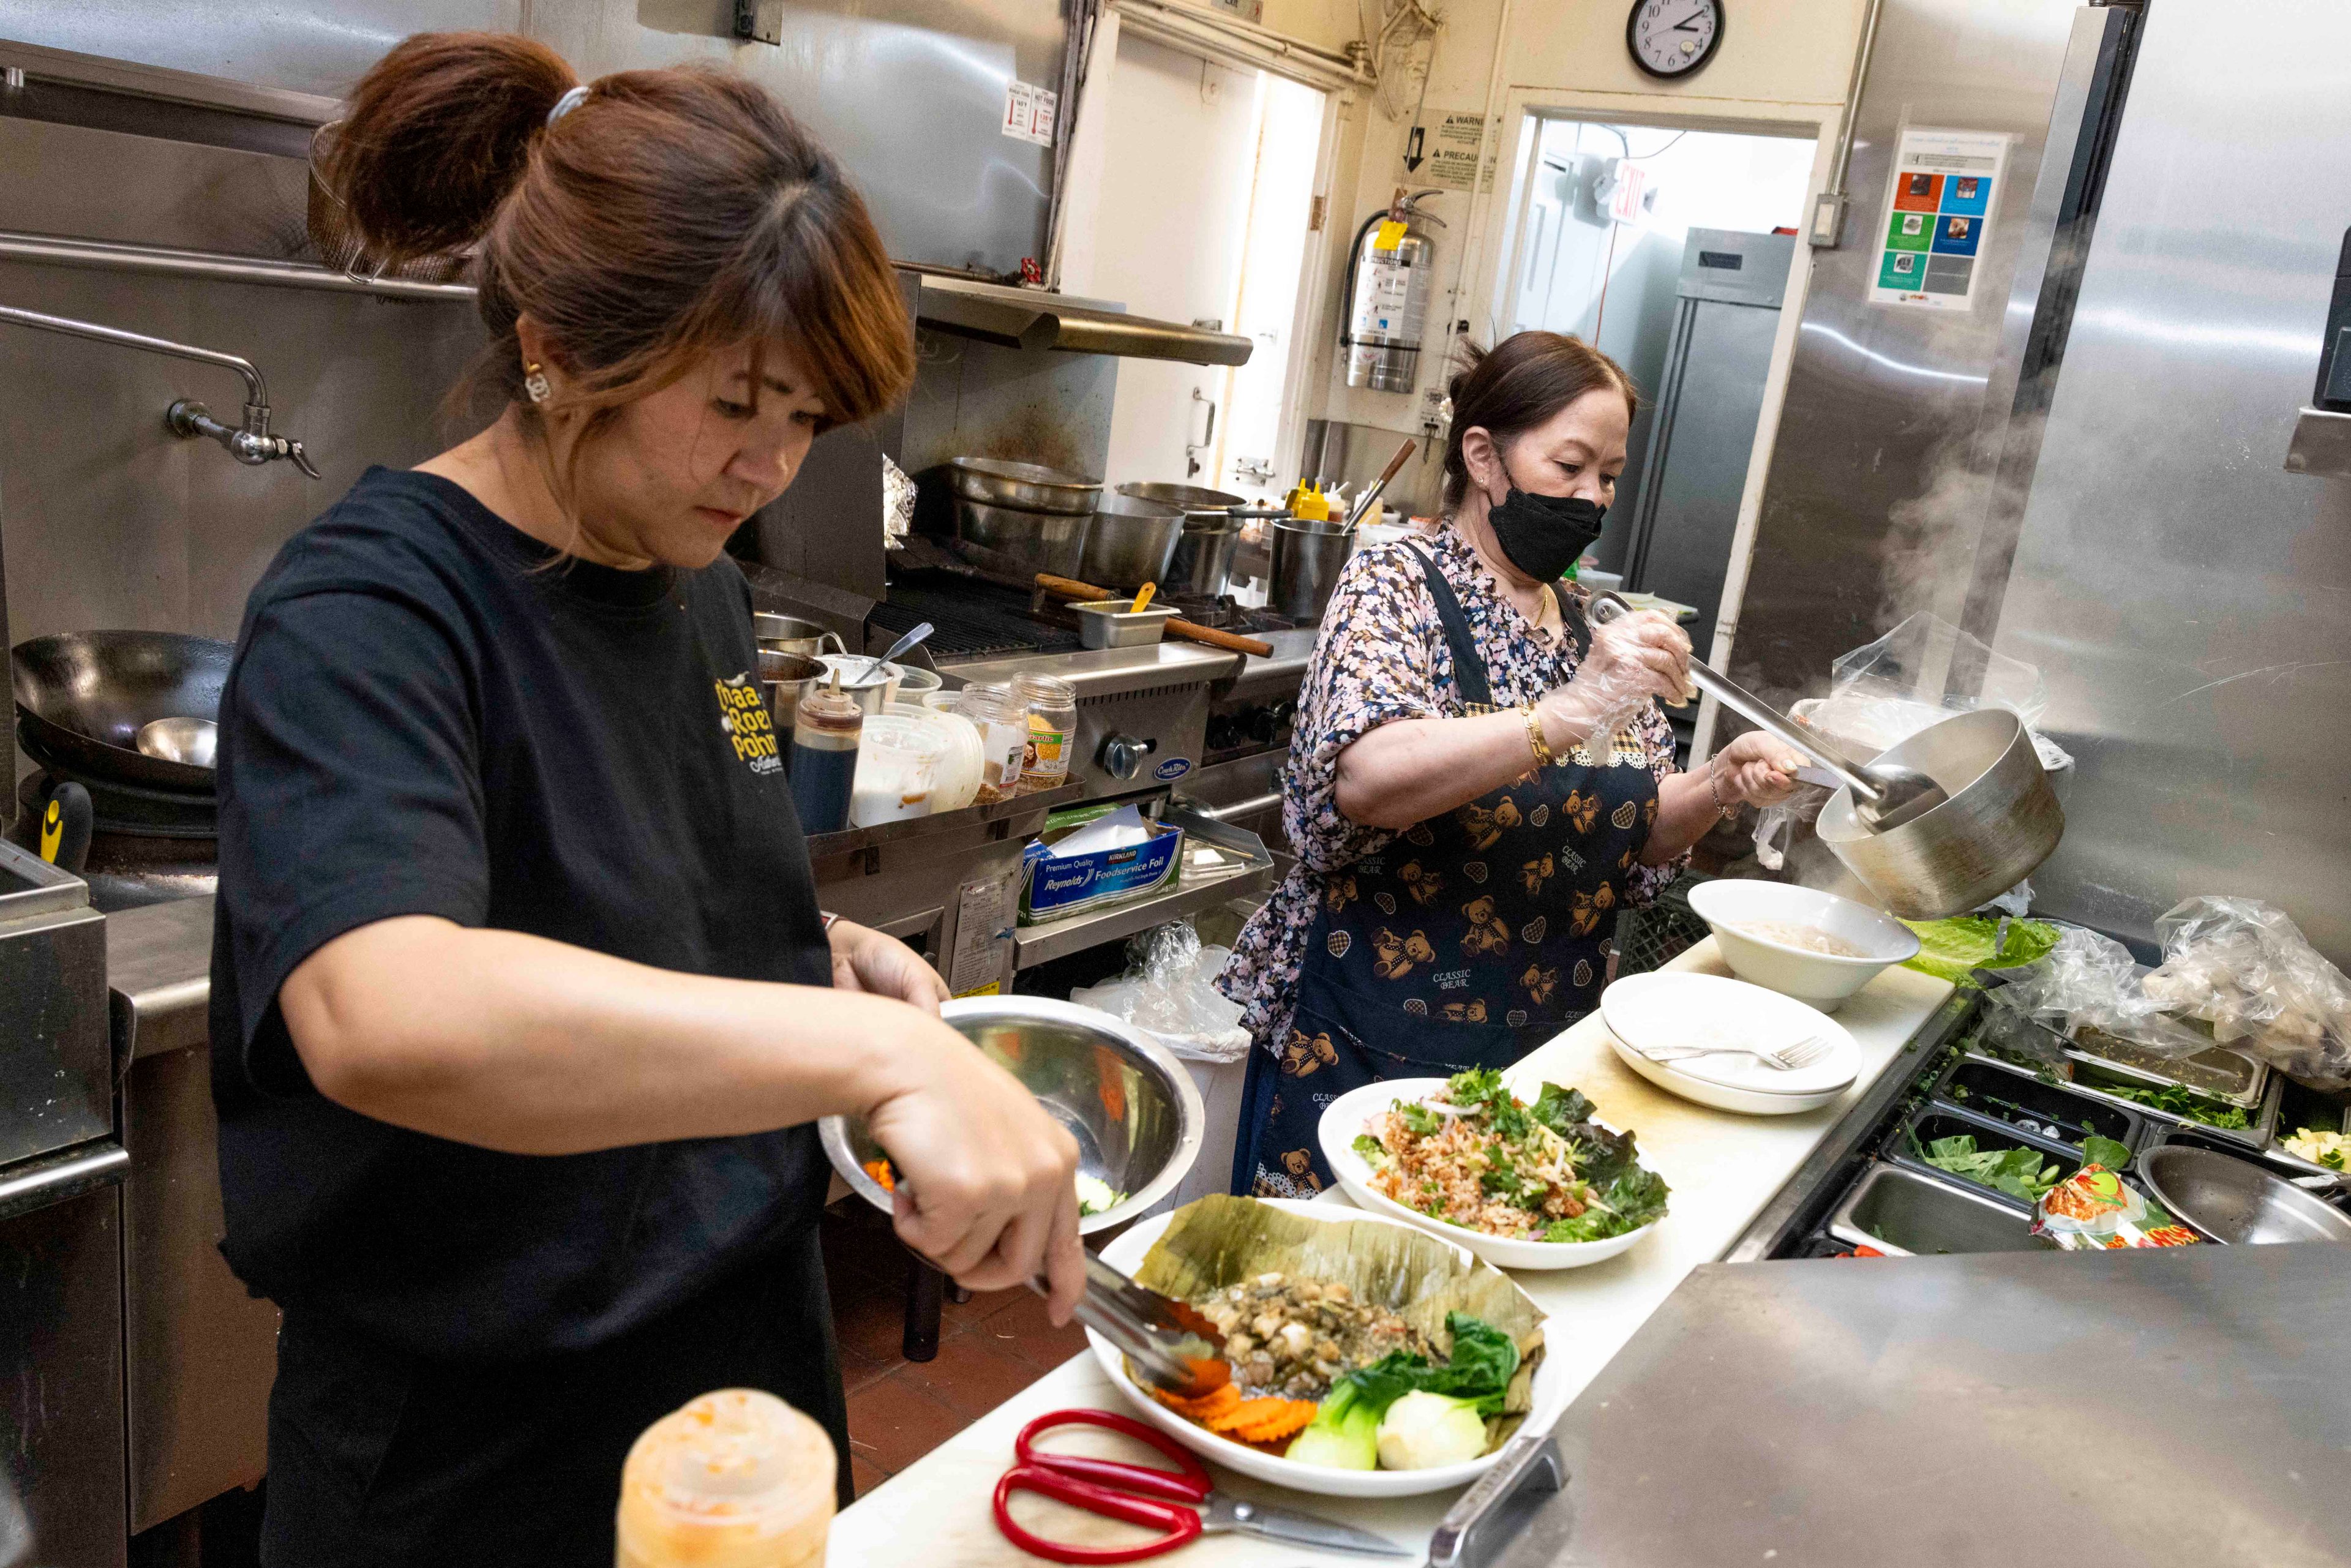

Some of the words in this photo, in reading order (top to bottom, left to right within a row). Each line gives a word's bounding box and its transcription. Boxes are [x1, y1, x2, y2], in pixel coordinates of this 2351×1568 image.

[1649, 4, 1660, 18] 10
[1702, 5, 1710, 18] 2
[1642, 20, 1649, 31] 9
[1704, 21, 1712, 34] 3
[1644, 37, 1651, 49] 8
[1696, 38, 1703, 50] 4
[1655, 50, 1661, 62] 7
[1668, 54, 1675, 67] 6
[1456, 116, 1483, 126] WARNI
[1615, 163, 1645, 220] EXIT
[1029, 733, 1053, 743] Garlic
[1109, 850, 1136, 861] KIRKLAND
[1562, 846, 1586, 868] CLASSIC
[1046, 863, 1072, 872] Premium
[1074, 859, 1094, 868] Quality
[1095, 863, 1147, 880] Foodservice
[1149, 856, 1164, 869] Foil
[1358, 866, 1382, 875] BEAR
[1562, 856, 1578, 874] BEAR
[1044, 876, 1082, 891] Reynolds
[1433, 969, 1471, 982] CLASSIC
[1440, 978, 1469, 989] BEAR
